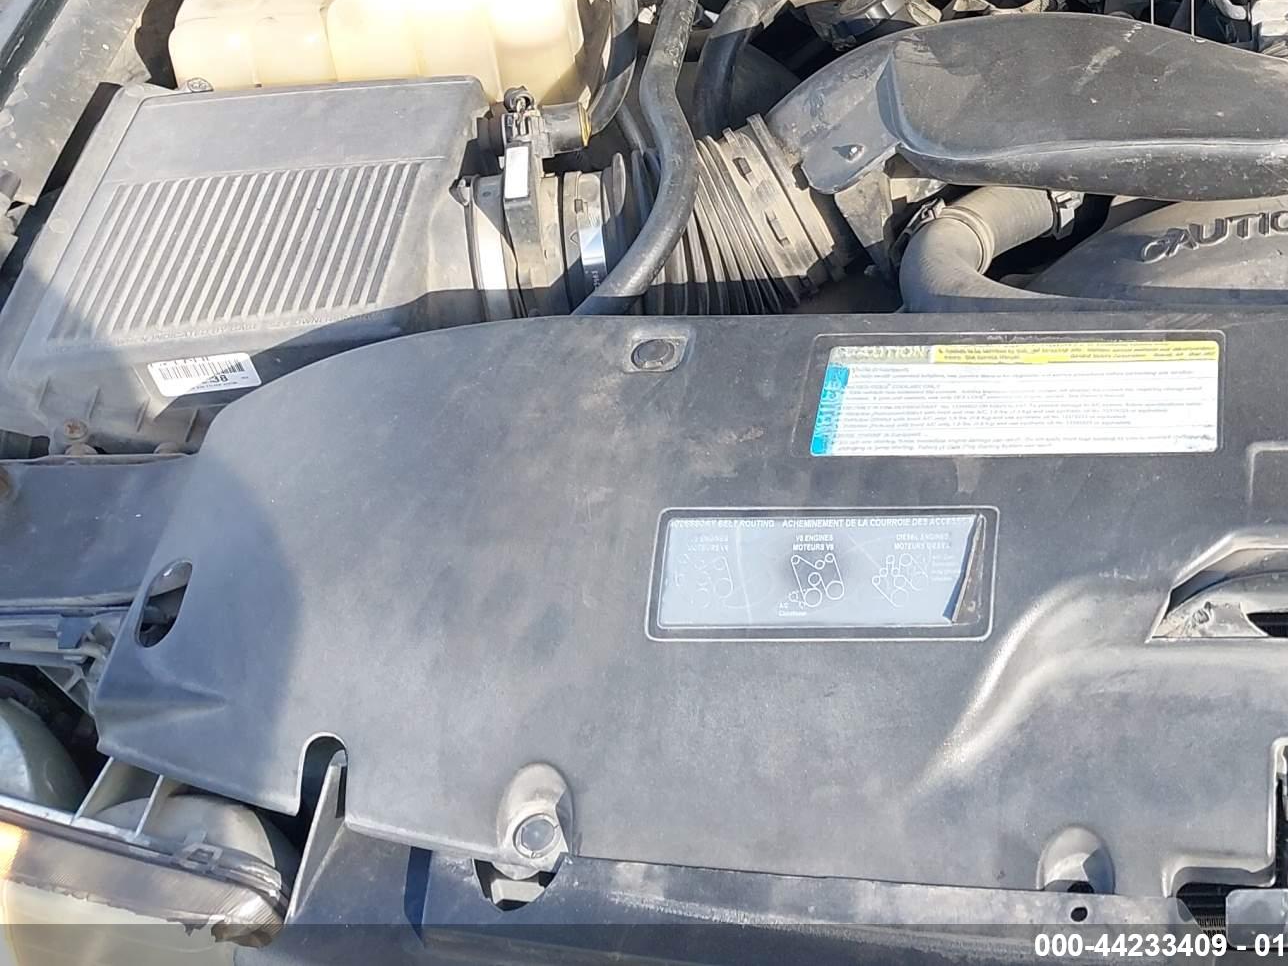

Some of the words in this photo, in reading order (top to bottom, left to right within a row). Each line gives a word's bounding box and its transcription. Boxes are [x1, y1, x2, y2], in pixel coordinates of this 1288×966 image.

[782, 519, 844, 529] ACHEMINEMENT
[845, 519, 856, 528] DE
[857, 519, 868, 528] LA
[792, 543, 824, 551] MOTEURS
